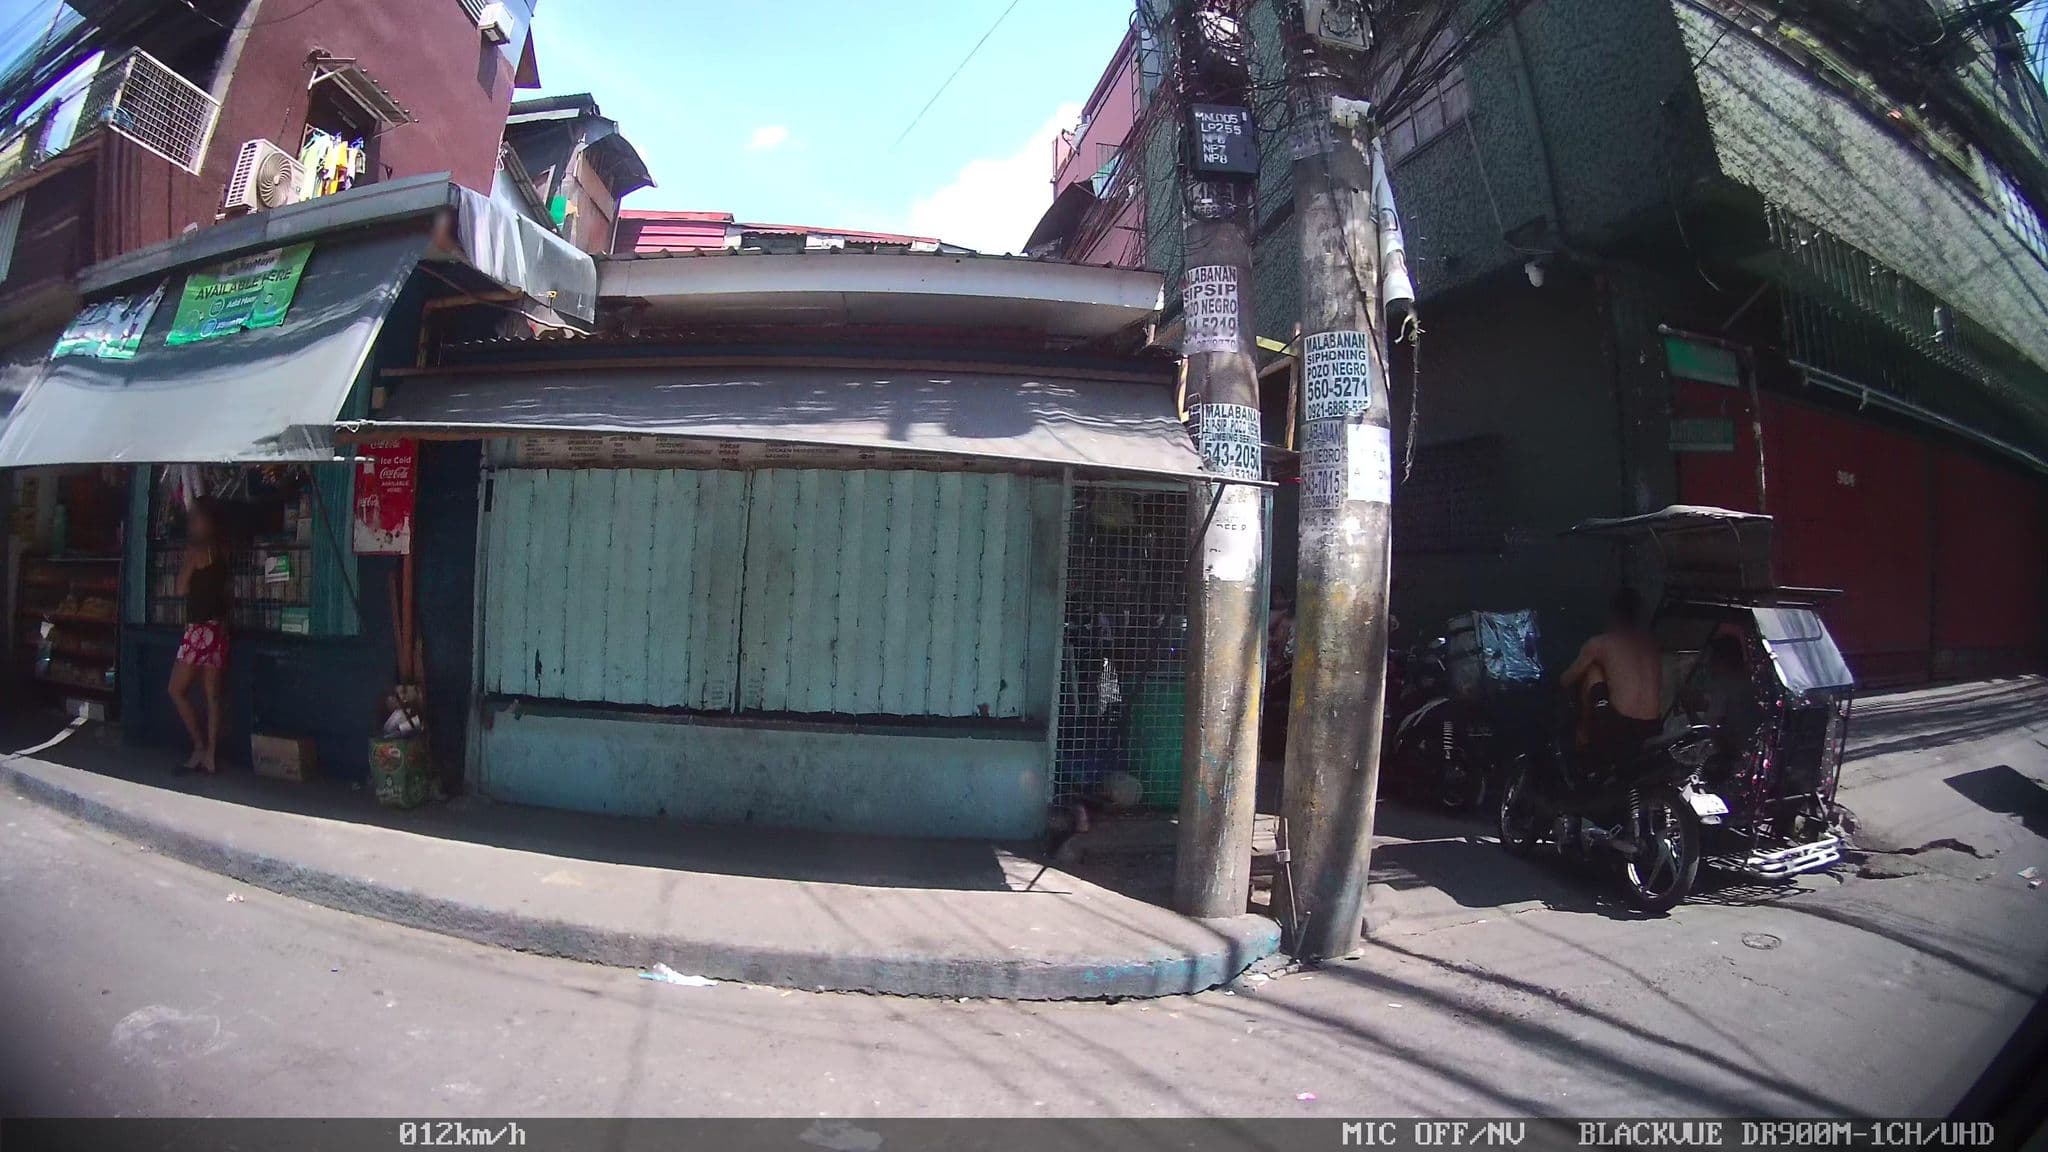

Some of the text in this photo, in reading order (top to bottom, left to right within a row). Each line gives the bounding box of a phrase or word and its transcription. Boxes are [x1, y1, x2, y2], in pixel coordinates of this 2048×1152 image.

[1201, 123, 1242, 135] LP255
[1203, 143, 1226, 154] NP7
[1204, 153, 1228, 164] NP8
[195, 274, 262, 301] AVAILABLE
[1201, 299, 1237, 315] NEGRO
[1306, 332, 1366, 353] MALABANAN
[1307, 350, 1366, 365] SIPHONING
[1307, 362, 1367, 380] POZO NEGRO
[1307, 377, 1368, 401] 560-5271
[380, 456, 412, 465] Ice Cold
